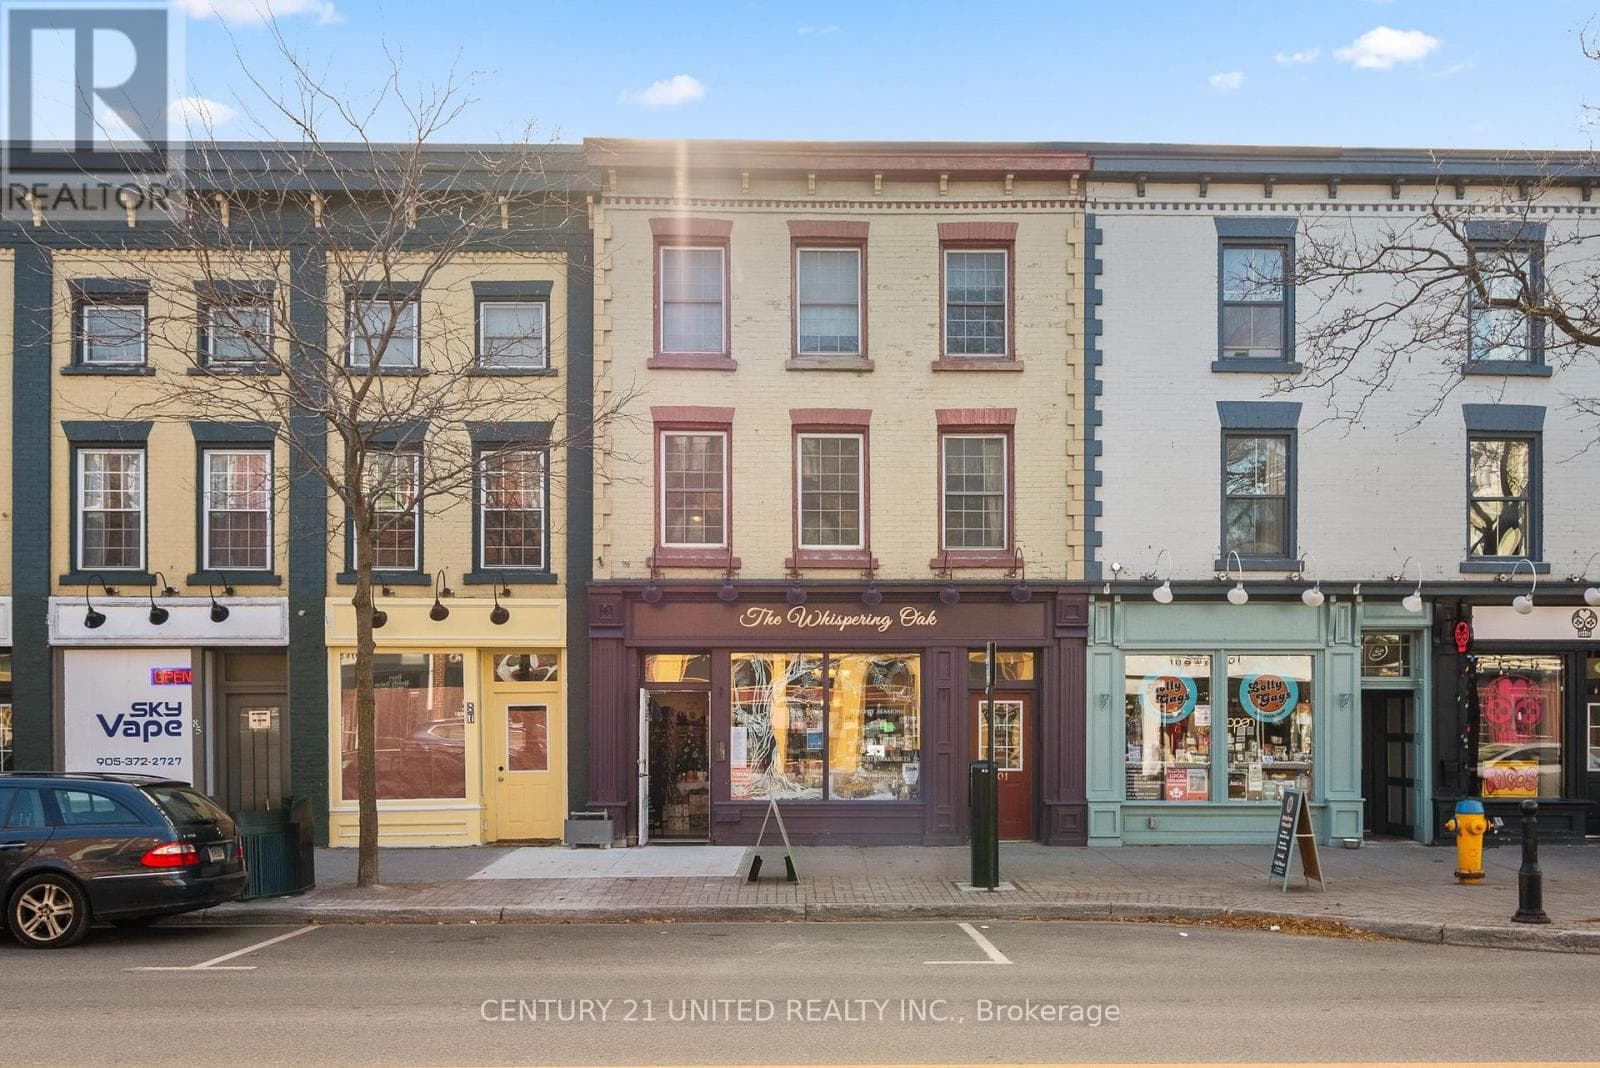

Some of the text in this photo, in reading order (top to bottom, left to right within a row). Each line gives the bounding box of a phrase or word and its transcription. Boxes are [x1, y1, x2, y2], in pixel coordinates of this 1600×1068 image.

[739, 605, 938, 633] The Whispering Oak
[154, 670, 192, 684] OPEN
[1247, 680, 1283, 695] Lolly
[96, 713, 182, 743] Vape
[96, 756, 182, 767] 905-372-2727
[1483, 767, 1537, 795] TACOS
